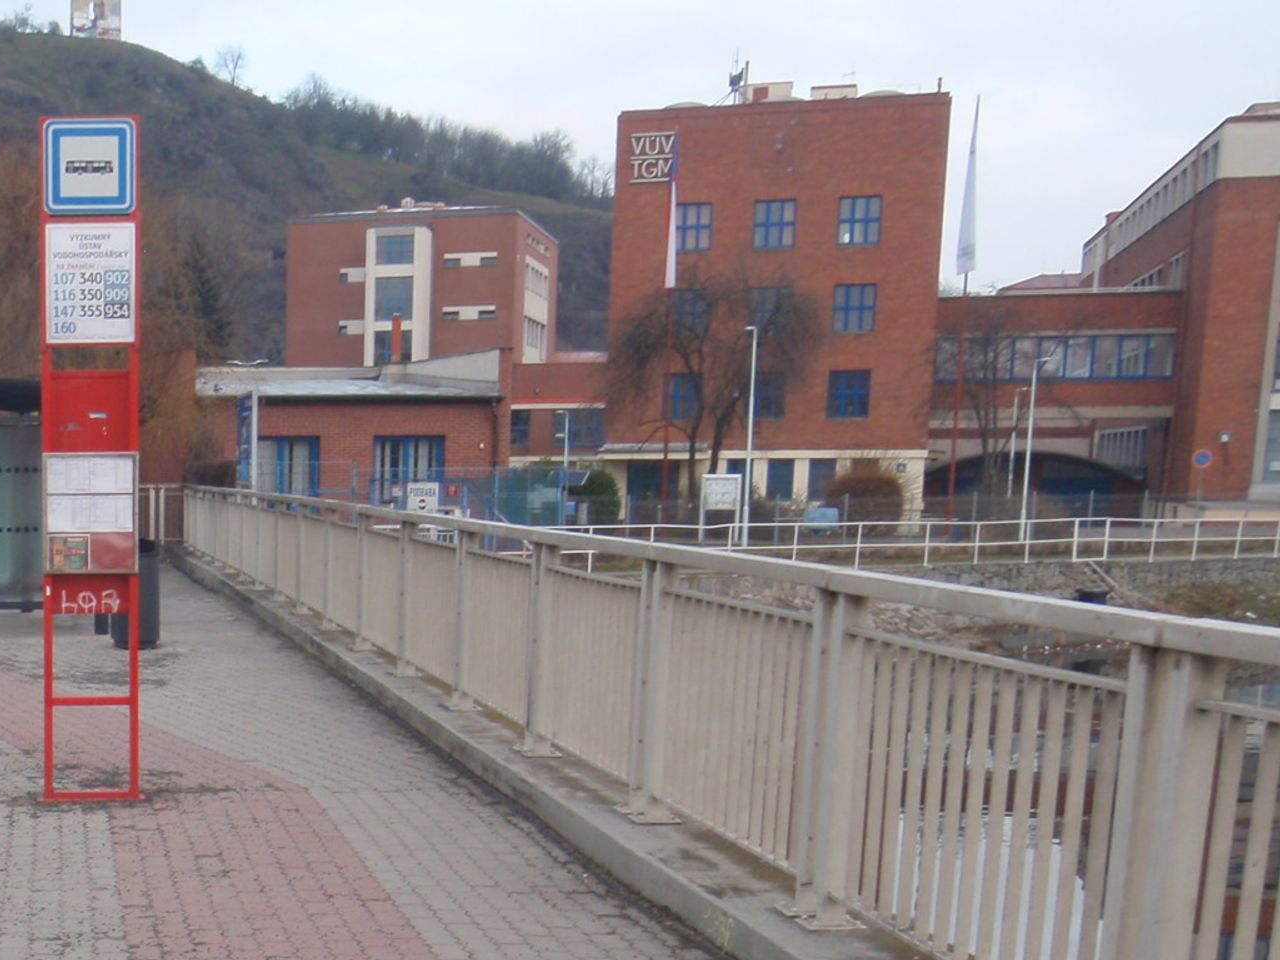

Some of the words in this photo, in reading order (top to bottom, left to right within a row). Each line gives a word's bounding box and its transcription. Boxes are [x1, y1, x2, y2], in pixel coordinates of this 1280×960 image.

[632, 136, 674, 154] VÚV
[70, 233, 111, 241] VÝZKUMNÝ
[53, 272, 76, 285] 107
[79, 271, 103, 285] 340
[105, 271, 129, 285] 902
[53, 288, 76, 301] 116
[79, 288, 103, 301] 350
[105, 288, 129, 301] 909
[53, 305, 76, 318] 147
[79, 304, 103, 318] 355
[105, 304, 129, 318] 954
[53, 321, 77, 334] 160
